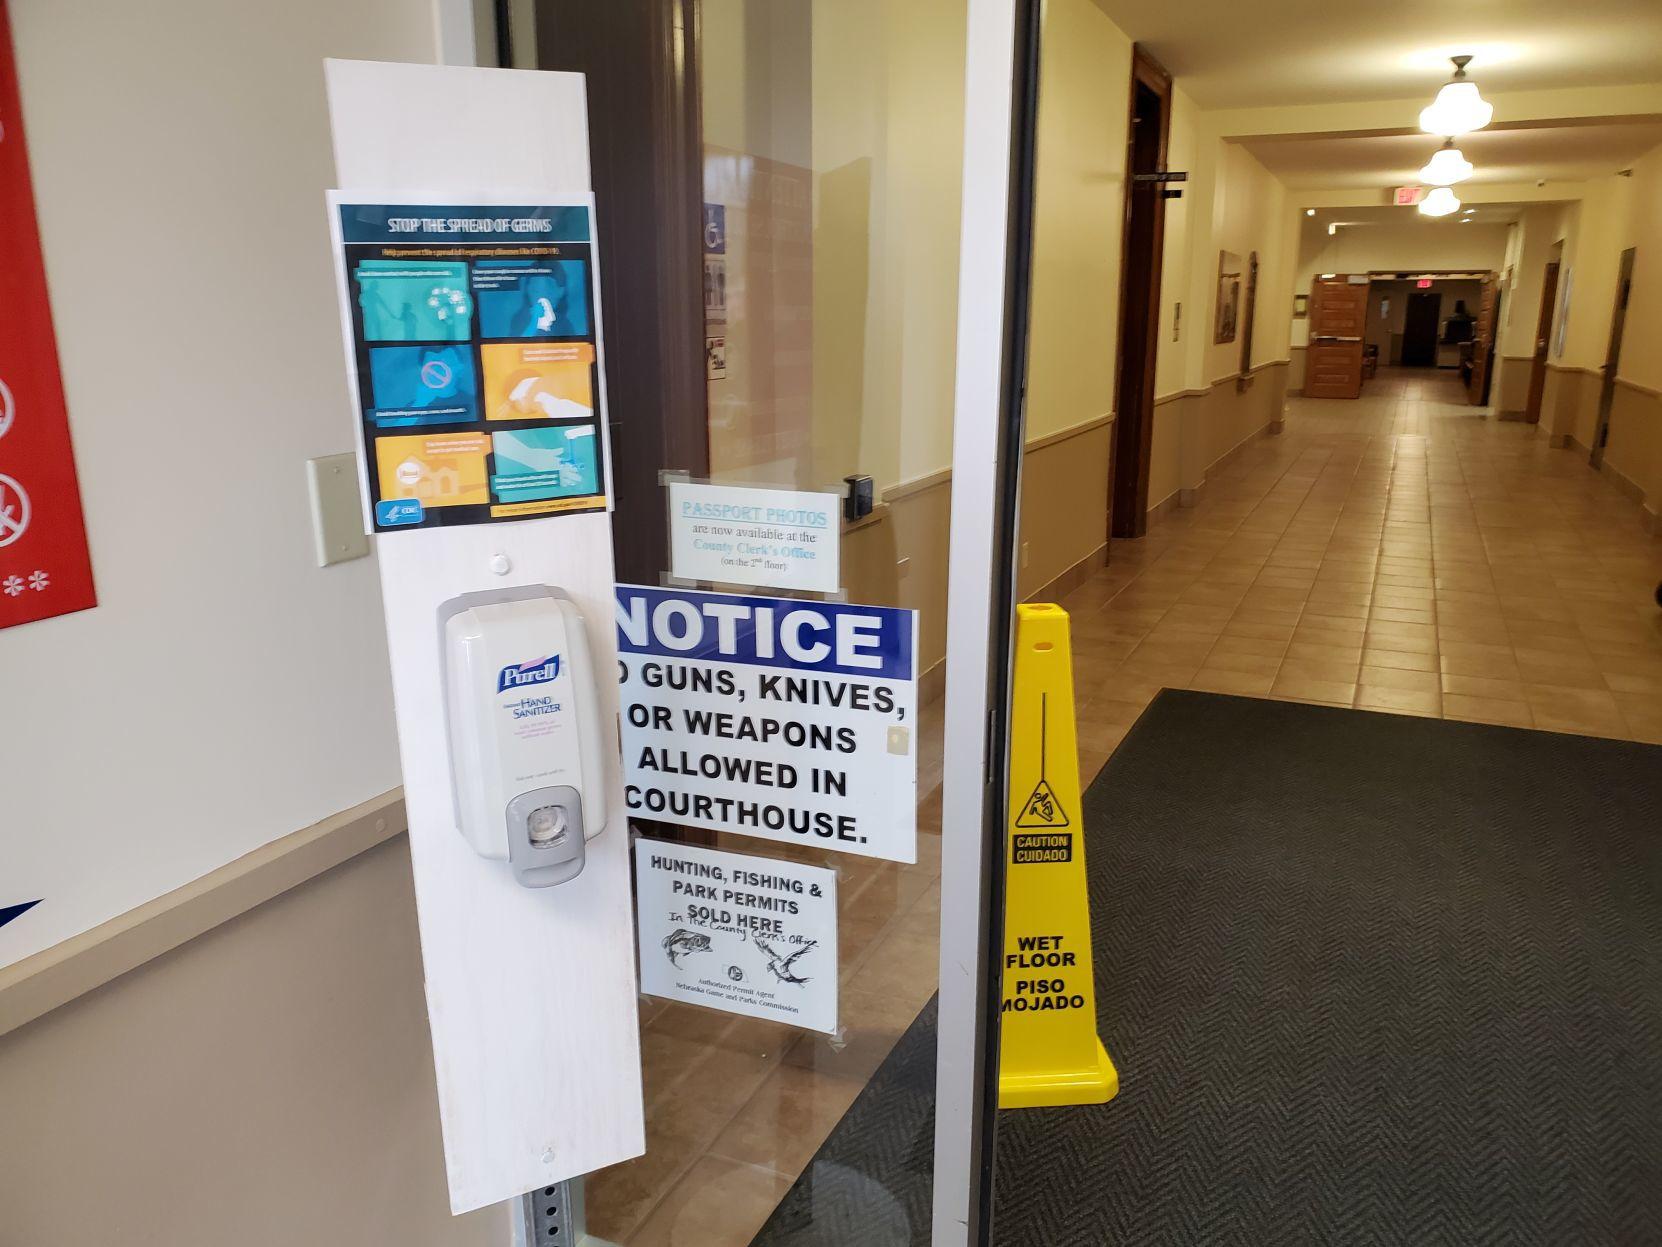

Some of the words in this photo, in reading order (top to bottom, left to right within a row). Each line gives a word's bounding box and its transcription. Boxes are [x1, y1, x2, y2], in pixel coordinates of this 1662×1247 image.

[388, 218, 420, 233] STOP
[421, 218, 447, 233] THE
[447, 218, 494, 233] SPREAD
[494, 218, 511, 233] OF
[511, 218, 553, 233] GERMS
[682, 501, 762, 520] PASSPORT
[767, 509, 827, 526] PHOTOS
[693, 525, 708, 534] are
[711, 527, 732, 537] now
[736, 527, 783, 541] available
[786, 532, 797, 541] at
[799, 532, 816, 543] the
[693, 538, 732, 553] County
[736, 542, 778, 556] Clerk's
[781, 546, 816, 560] Office
[720, 556, 734, 567] (on
[736, 557, 748, 567] the
[750, 557, 762, 568] 2nd
[616, 597, 883, 669] NOTICE
[504, 662, 557, 687] Purell
[521, 697, 551, 709] HAND
[642, 662, 745, 703] GUNS,
[759, 674, 905, 721] KNIVES,
[513, 703, 561, 719] SANITIZER
[627, 703, 673, 731] OR
[684, 709, 857, 754] WEAPONS
[638, 746, 797, 790] ALLOWED
[811, 768, 846, 797] IN
[625, 784, 867, 844] COURTHOUSE.
[1017, 835, 1068, 848] CAUTION
[1016, 849, 1067, 862] CUIDADO
[651, 855, 727, 884] HUNTING,
[733, 870, 803, 894] FISHING
[809, 883, 823, 898] &
[673, 880, 718, 901] PARK
[723, 890, 799, 915] PERMITS
[668, 911, 684, 922] In
[687, 916, 708, 928] The
[710, 921, 746, 941] County
[687, 904, 731, 924] SOLD
[737, 914, 783, 934] HERE
[1017, 935, 1064, 951] WET
[1006, 952, 1076, 969] FLOOR
[675, 981, 704, 994] Nebraska
[705, 988, 723, 998] Game
[725, 992, 738, 1001] and
[738, 994, 757, 1006] Parks
[758, 999, 799, 1014] Commission
[698, 978, 731, 991] Authorized
[732, 985, 754, 996] Permit
[756, 990, 775, 1000] Agent
[1016, 978, 1065, 995] PISO
